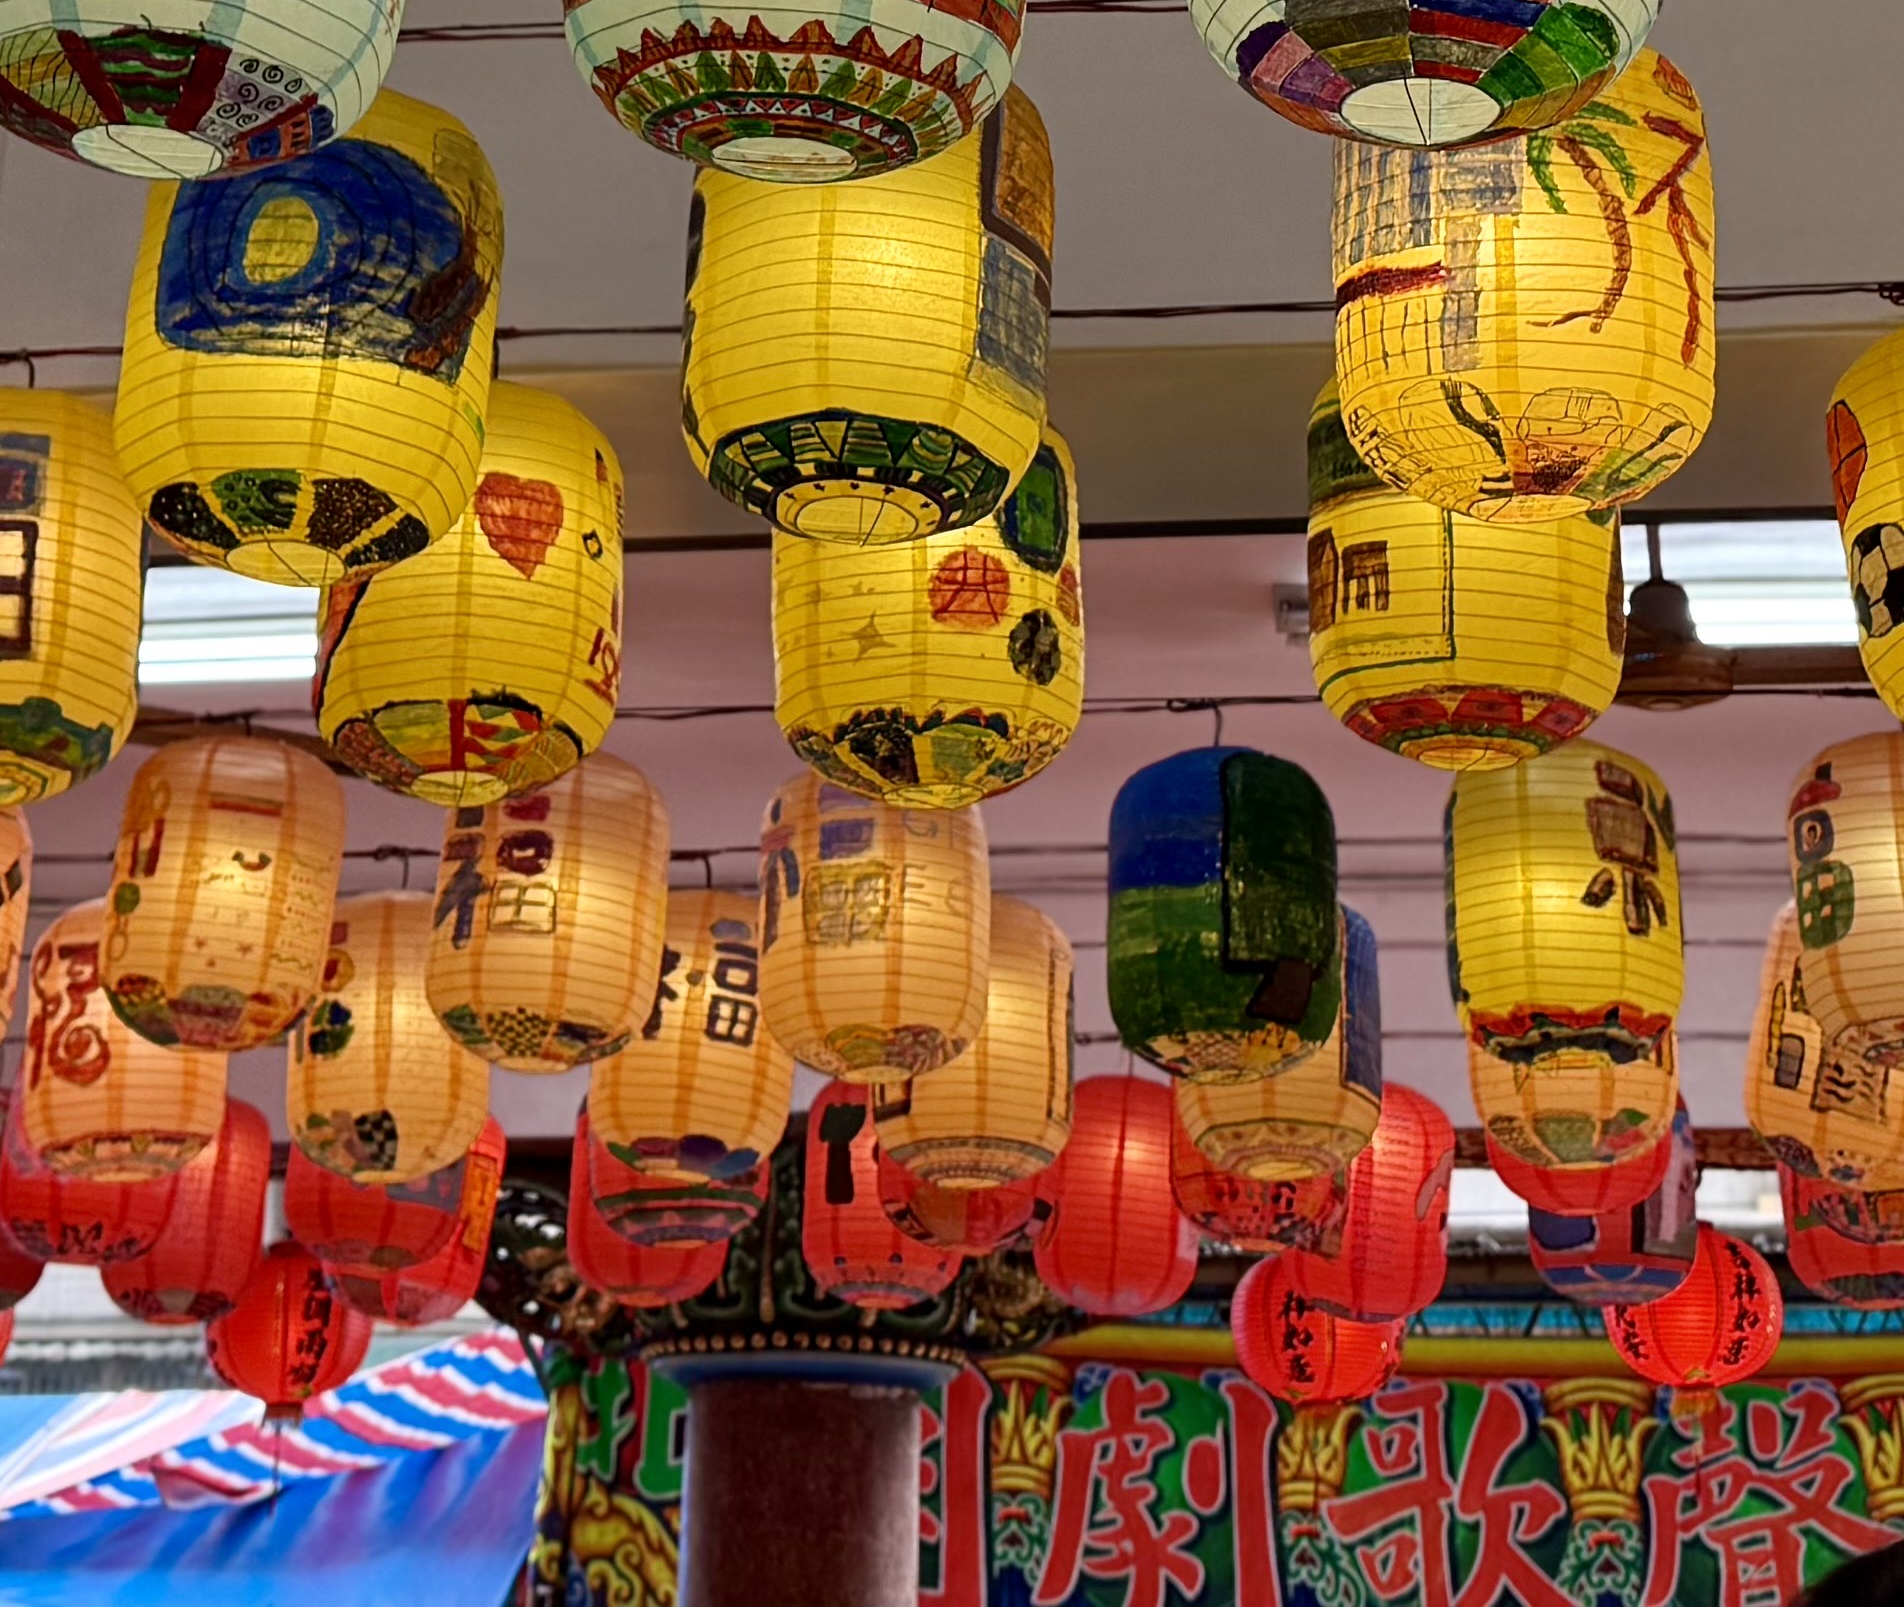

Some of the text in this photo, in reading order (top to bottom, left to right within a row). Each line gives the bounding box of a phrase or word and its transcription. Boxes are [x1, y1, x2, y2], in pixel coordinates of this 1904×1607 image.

[434, 796, 557, 950] 福
[1718, 1242, 1762, 1366] 吉祥如意
